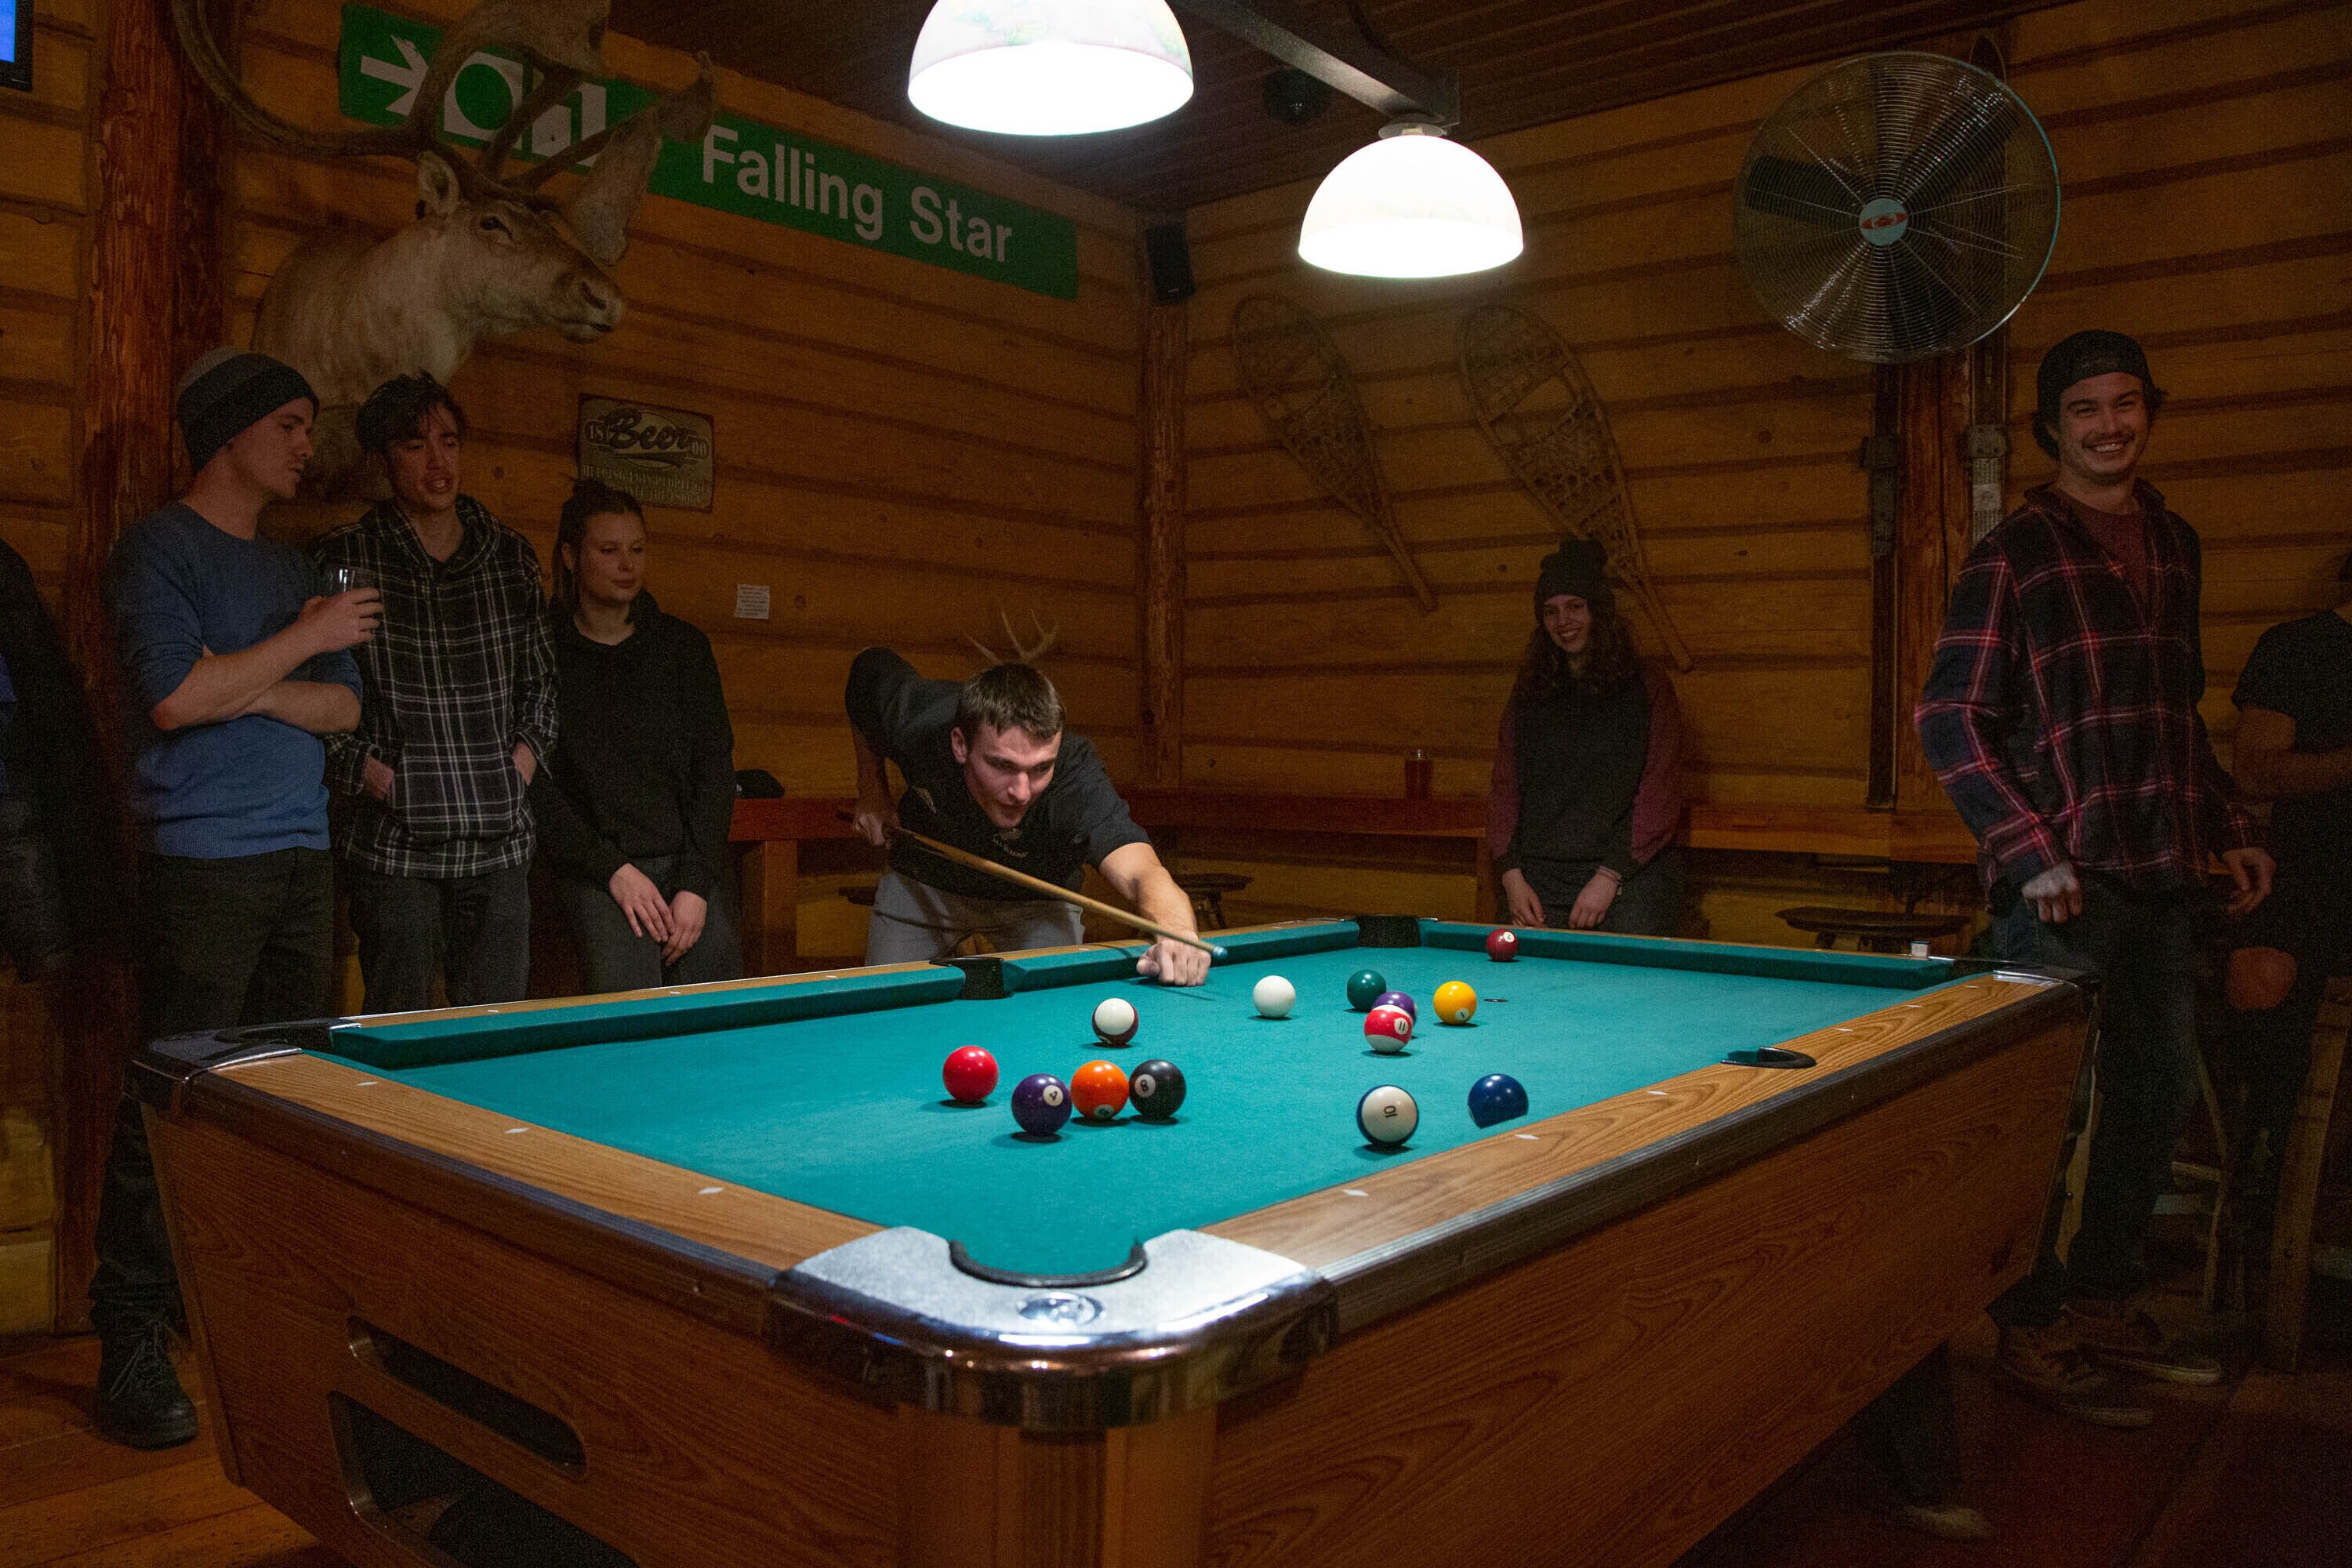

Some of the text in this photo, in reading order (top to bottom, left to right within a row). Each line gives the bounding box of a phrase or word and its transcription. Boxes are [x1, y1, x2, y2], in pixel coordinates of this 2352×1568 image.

[702, 125, 1013, 264] Falling Star
[597, 407, 699, 451] Beer
[1398, 1021, 1406, 1032] 11
[1140, 1080, 1149, 1092] 8
[1049, 1091, 1058, 1102] 4
[1383, 1105, 1398, 1118] 10
